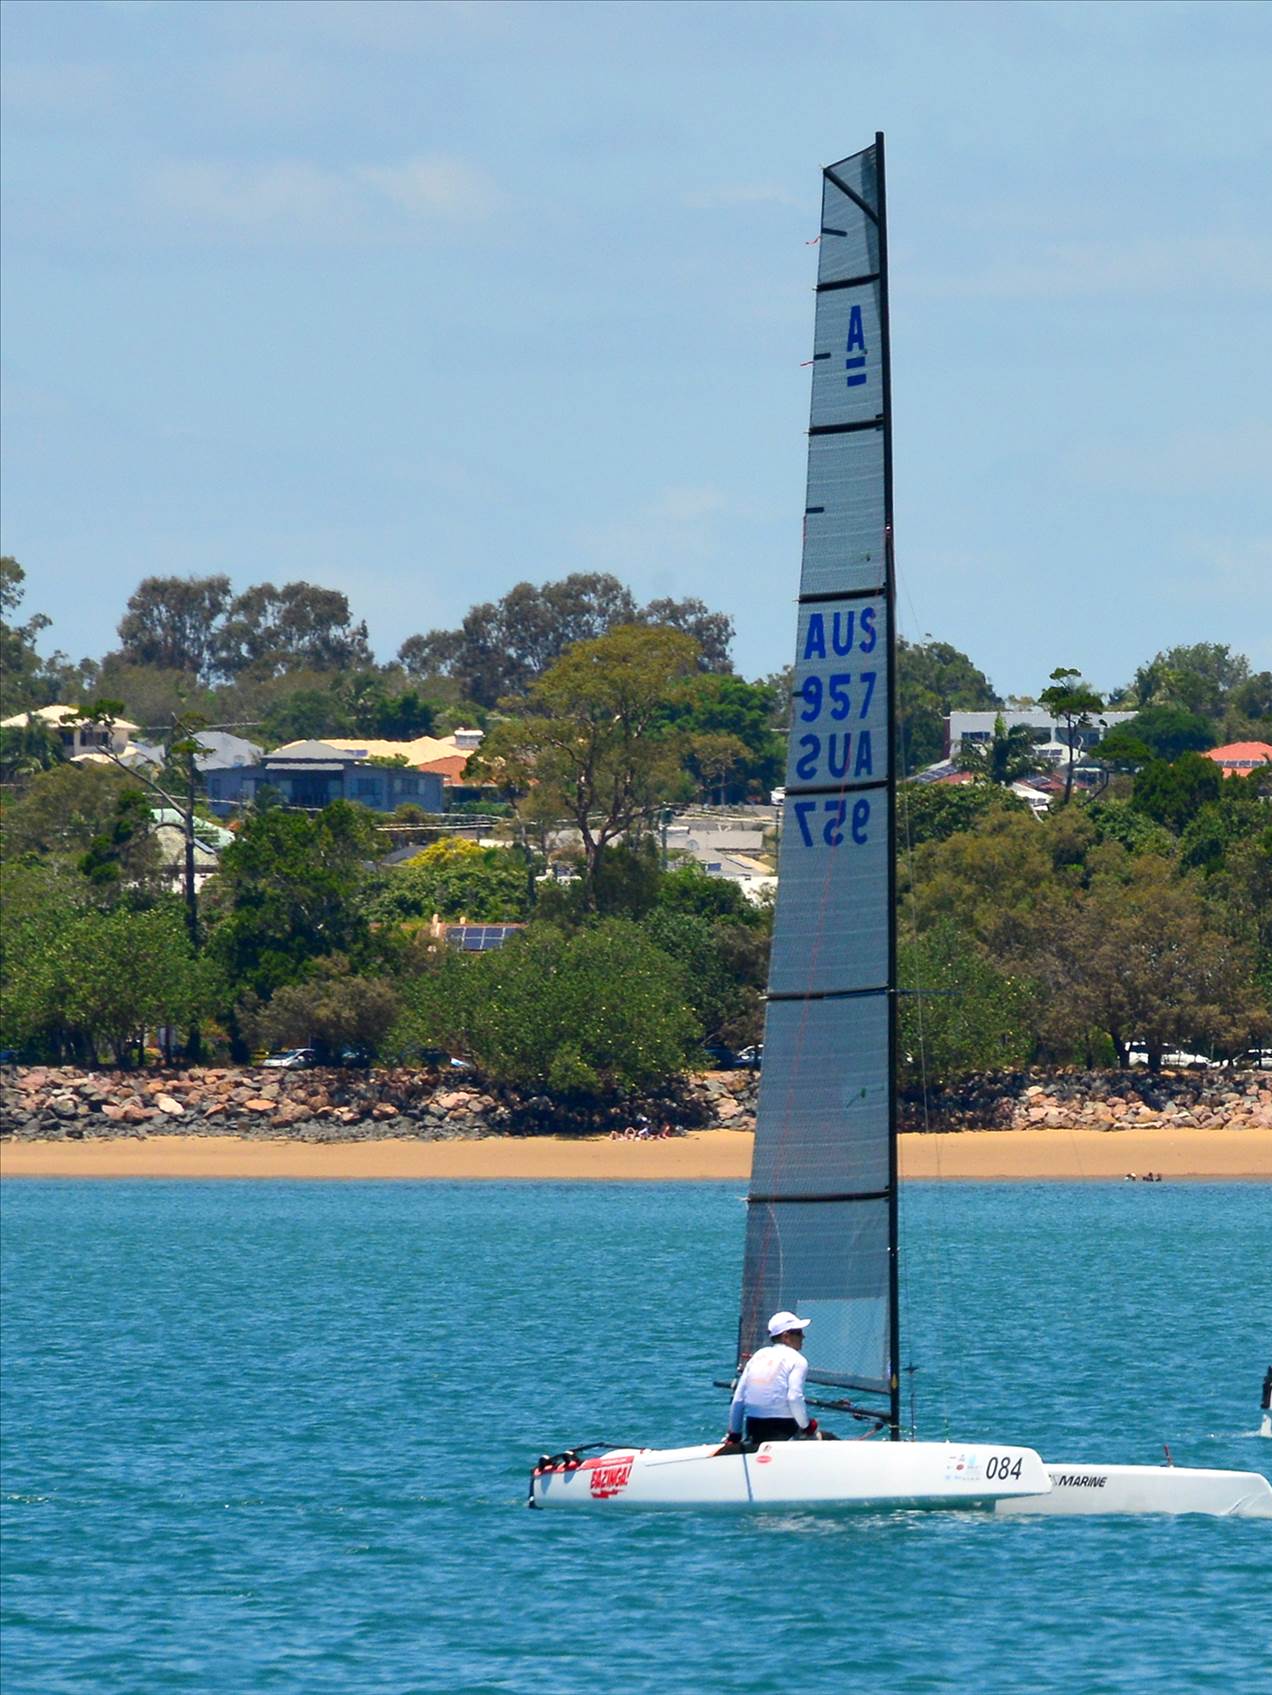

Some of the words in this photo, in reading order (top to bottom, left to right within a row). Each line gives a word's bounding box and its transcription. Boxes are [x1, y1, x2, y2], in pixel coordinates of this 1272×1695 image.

[847, 305, 865, 352] A
[804, 607, 877, 660] AUS
[801, 672, 877, 723] 957
[986, 1456, 1022, 1480] 084
[1059, 1475, 1107, 1487] MARINE
